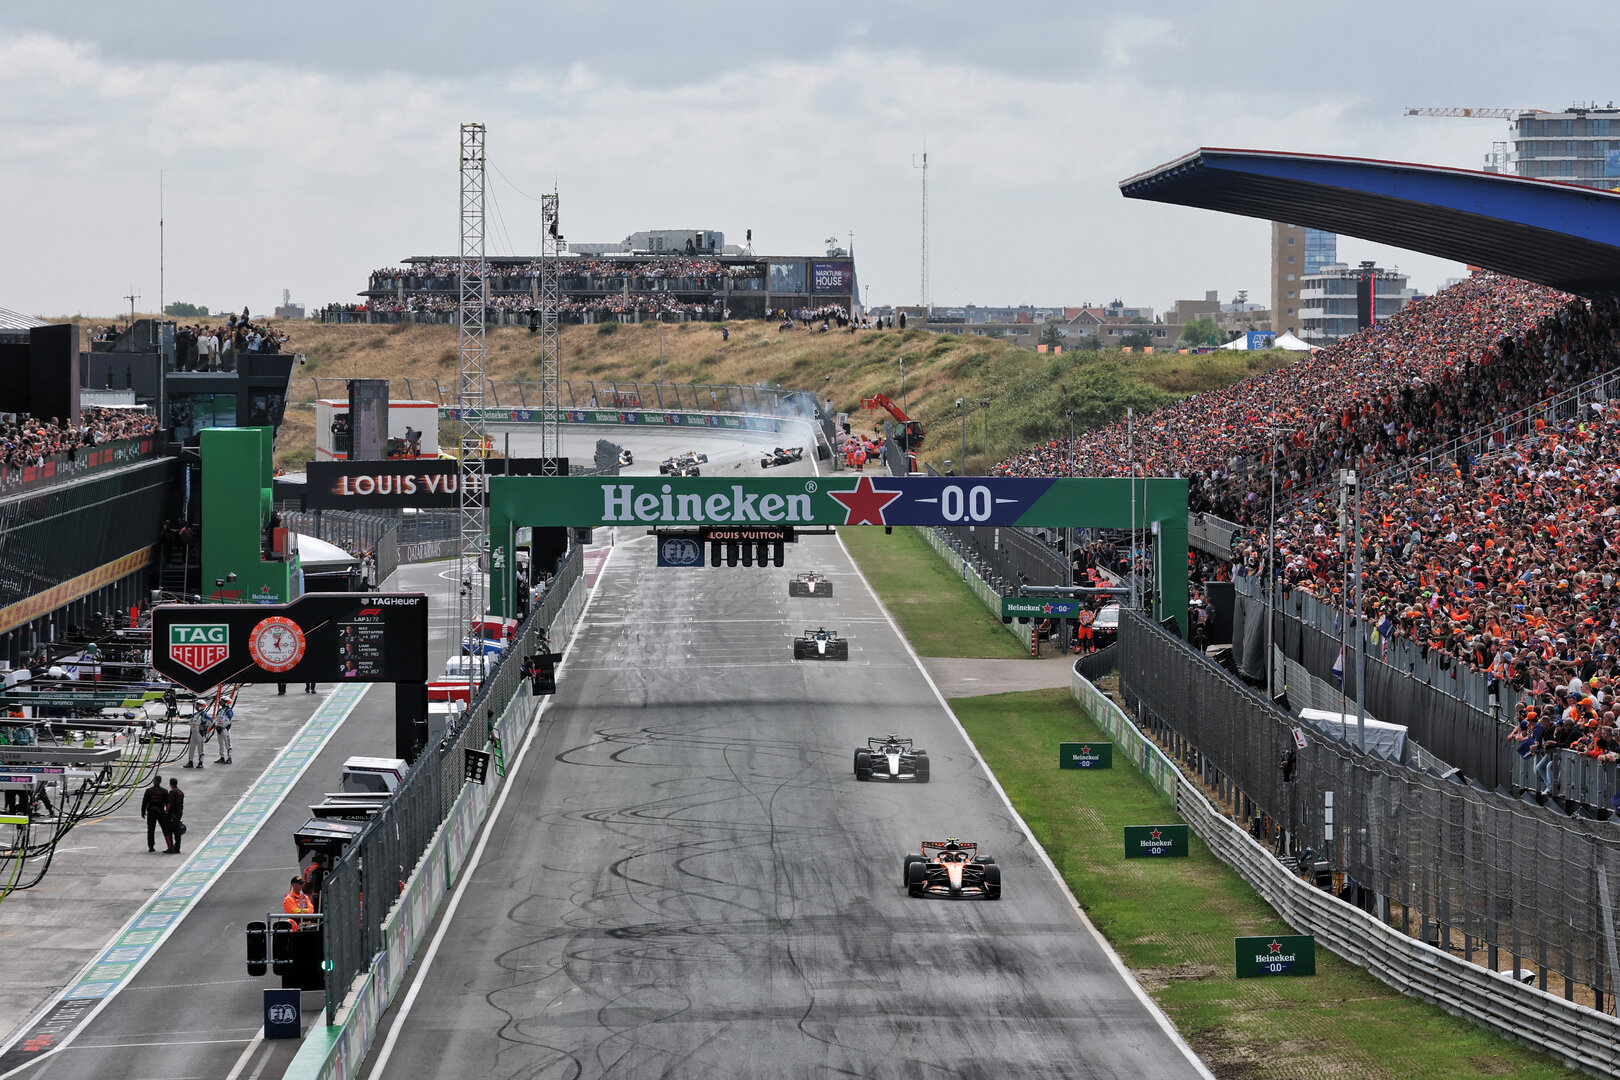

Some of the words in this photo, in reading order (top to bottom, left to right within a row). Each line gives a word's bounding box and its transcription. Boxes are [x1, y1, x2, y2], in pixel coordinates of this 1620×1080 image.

[816, 277, 842, 286] HOUSE
[343, 475, 417, 495] LOUIS
[424, 474, 491, 494] VUITT
[942, 485, 992, 522] 0.0
[710, 531, 739, 539] LOUIS
[741, 531, 784, 539] VUITTON
[407, 545, 423, 562] QATAR
[665, 544, 696, 558] FIA
[174, 627, 223, 642] TAG
[173, 647, 225, 670] HEUER
[1255, 954, 1295, 963] Heineken
[270, 1008, 293, 1020] FIA
